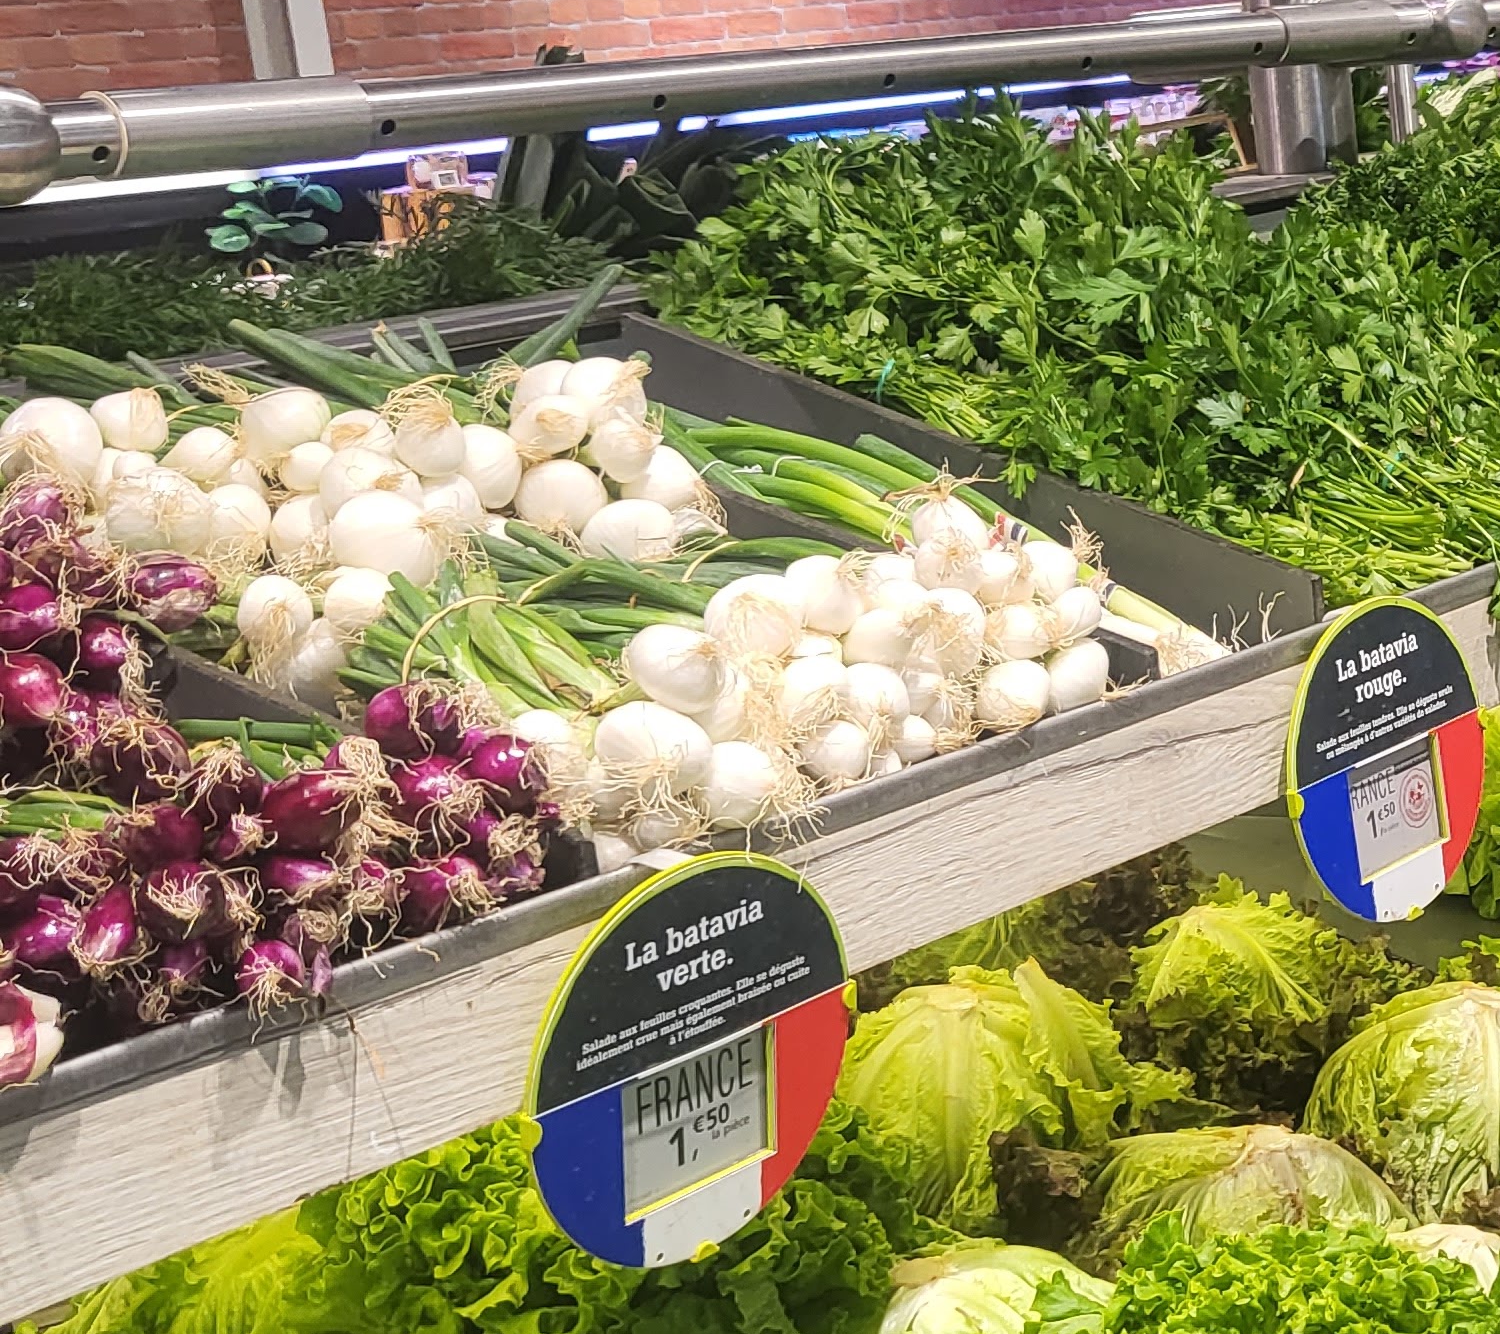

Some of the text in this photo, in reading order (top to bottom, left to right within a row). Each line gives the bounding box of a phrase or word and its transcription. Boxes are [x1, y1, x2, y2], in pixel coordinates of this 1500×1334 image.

[1335, 632, 1419, 683] La batavia
[1354, 667, 1407, 703] rouge.
[1377, 801, 1396, 821] €50
[624, 898, 764, 972] La batavia
[656, 948, 734, 992] verte.
[575, 966, 811, 1072] idéalement crue mais également braisée ou cuite
[581, 954, 806, 1056] Salade aux feuilles croquantes. Elle se déguste
[668, 1033, 677, 1046] à
[636, 1038, 753, 1136] FRANCE
[692, 1101, 730, 1134] €50
